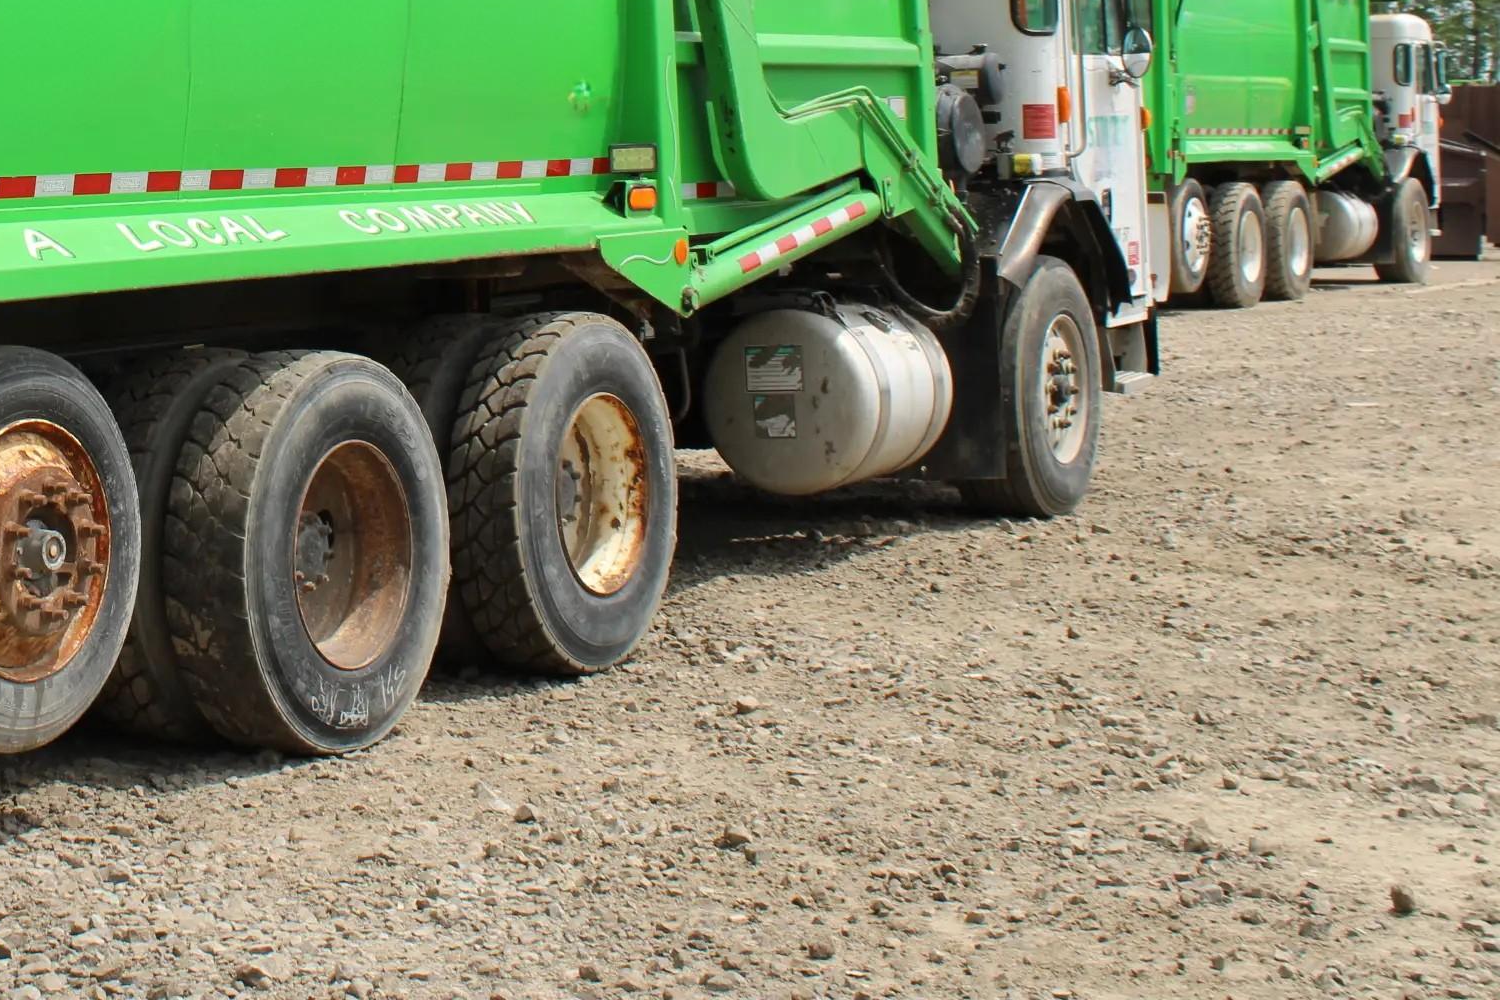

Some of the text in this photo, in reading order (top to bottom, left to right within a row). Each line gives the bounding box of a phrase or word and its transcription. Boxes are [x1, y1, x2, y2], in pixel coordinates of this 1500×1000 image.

[24, 200, 537, 260] A LOCAL COMPANY
